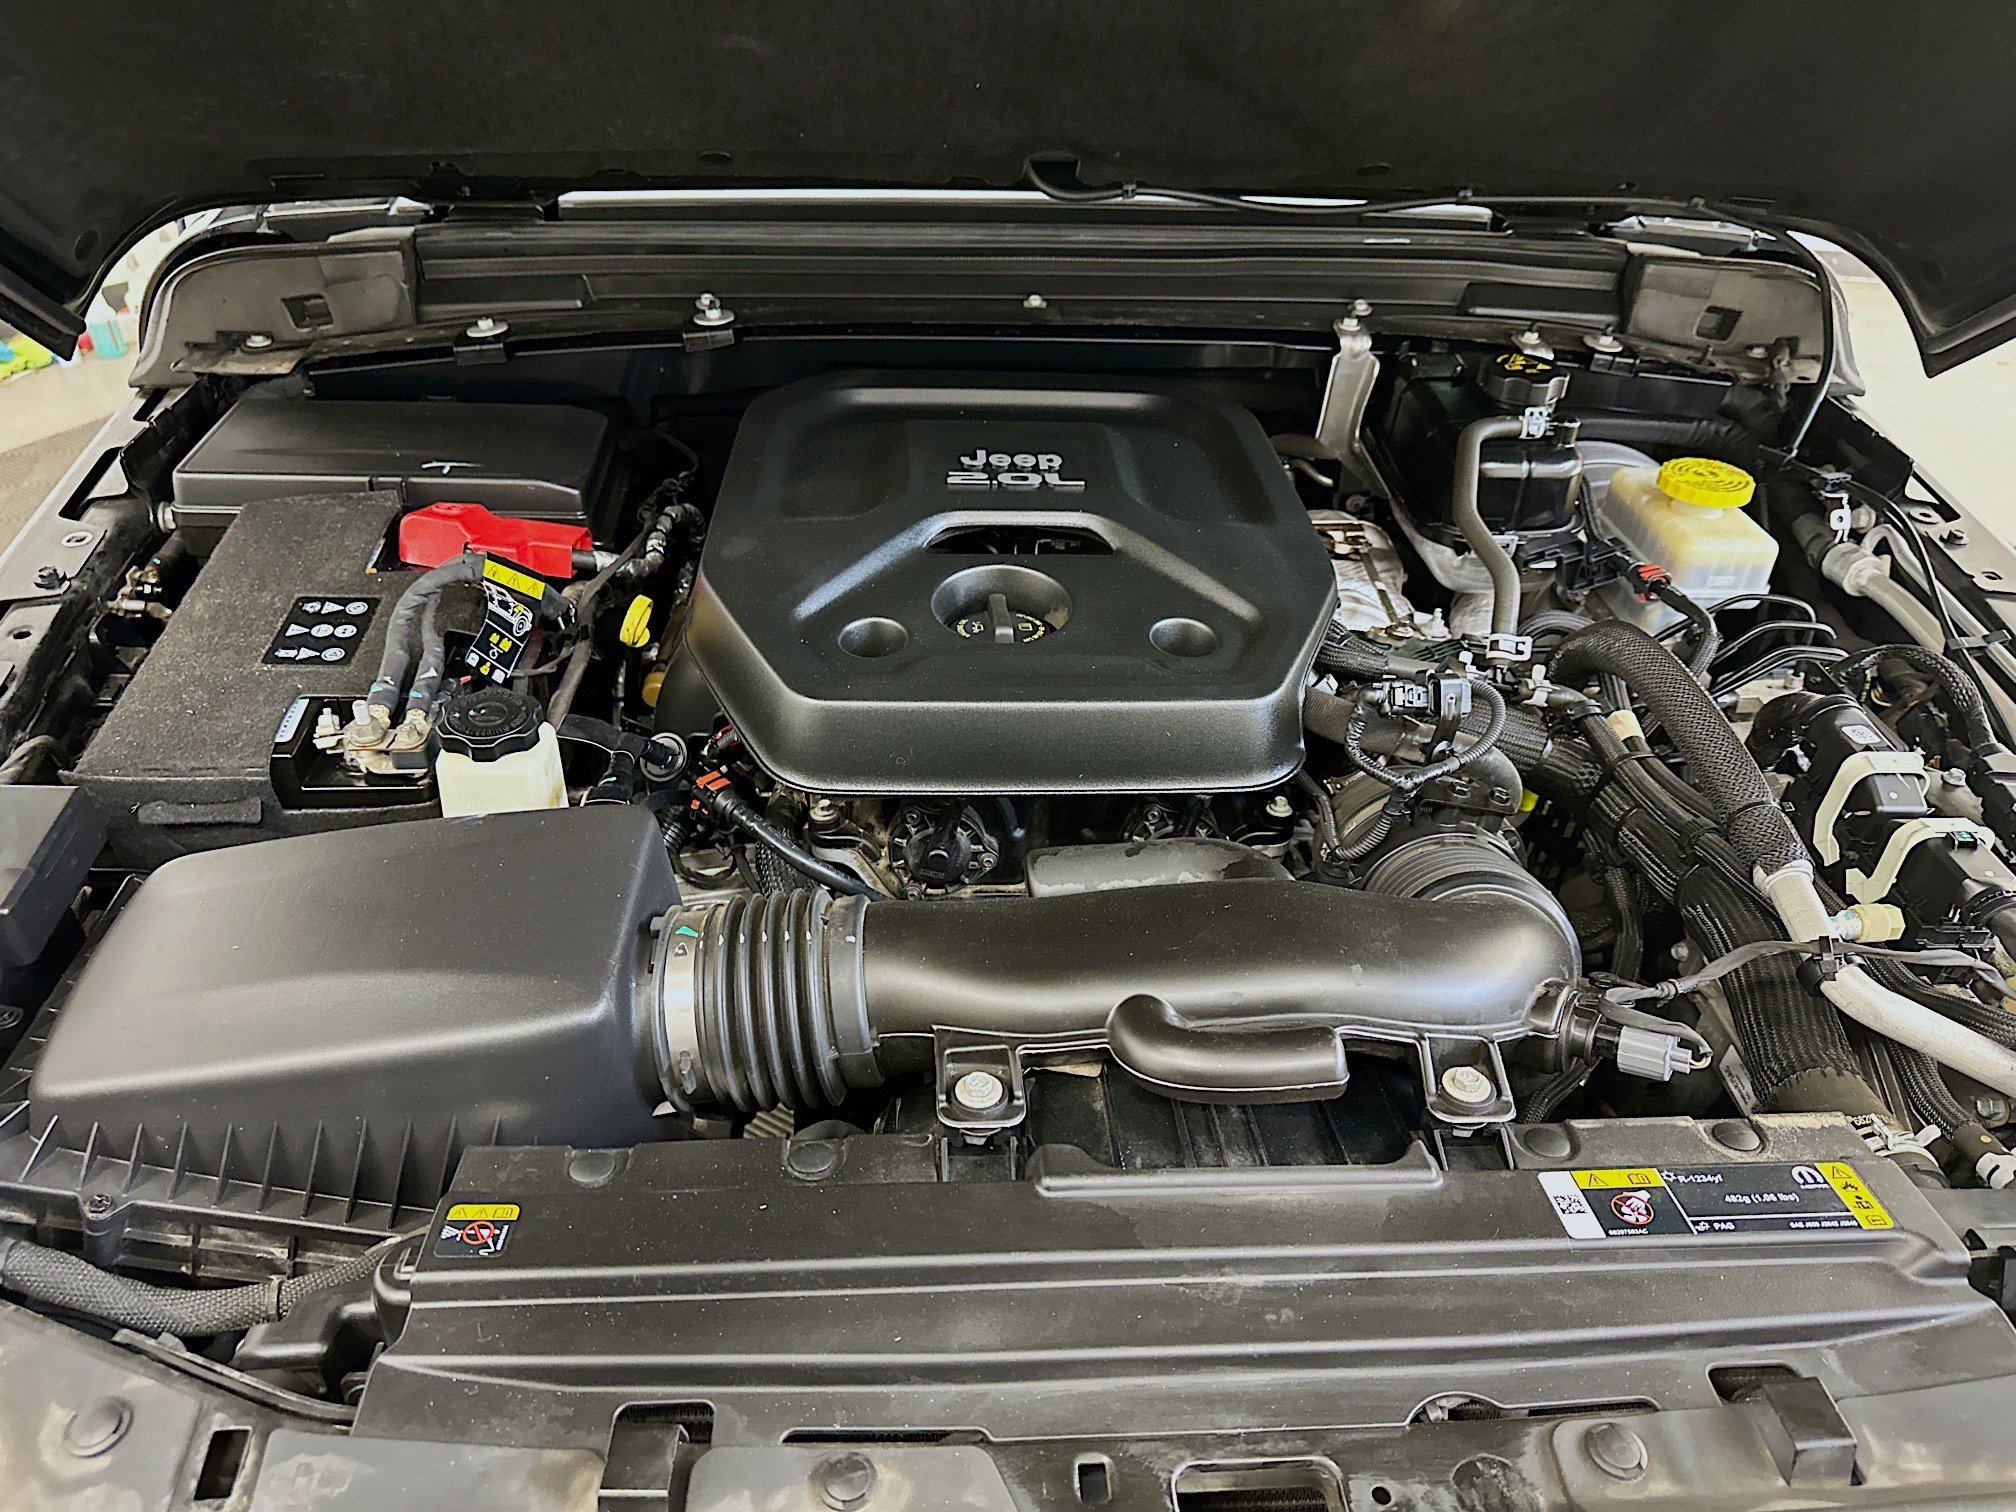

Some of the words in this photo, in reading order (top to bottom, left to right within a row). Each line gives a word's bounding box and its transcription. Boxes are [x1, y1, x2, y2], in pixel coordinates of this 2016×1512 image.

[960, 449, 1062, 470] Jeep
[947, 471, 1086, 487] 2.0L
[1713, 1222, 1735, 1231] PAG
